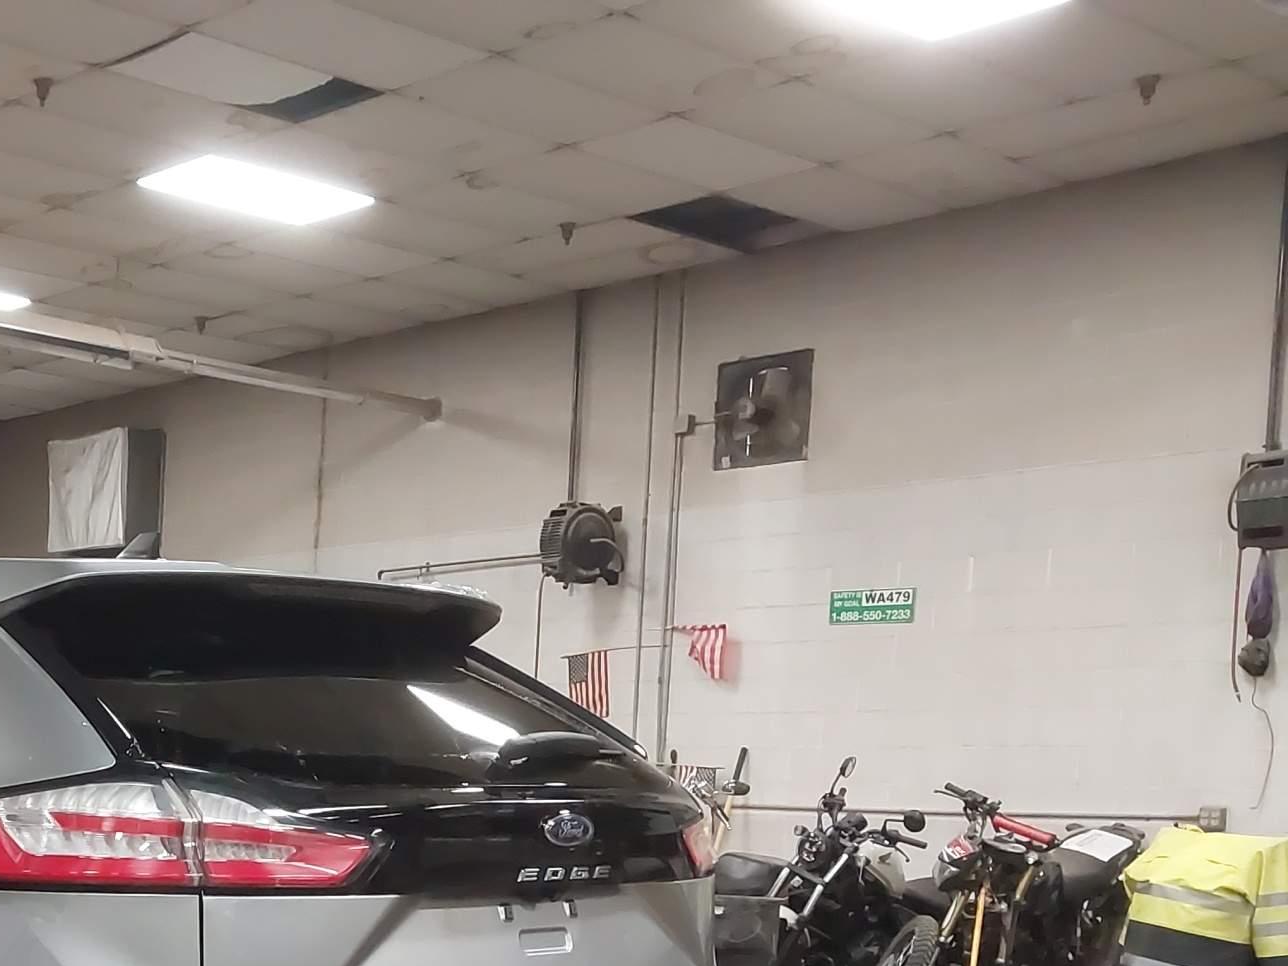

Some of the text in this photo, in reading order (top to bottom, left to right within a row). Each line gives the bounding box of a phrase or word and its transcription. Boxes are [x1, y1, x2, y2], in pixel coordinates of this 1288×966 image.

[865, 591, 910, 604] WA479
[832, 609, 911, 622] 1-888-550-7233
[517, 865, 611, 882] EDGE
